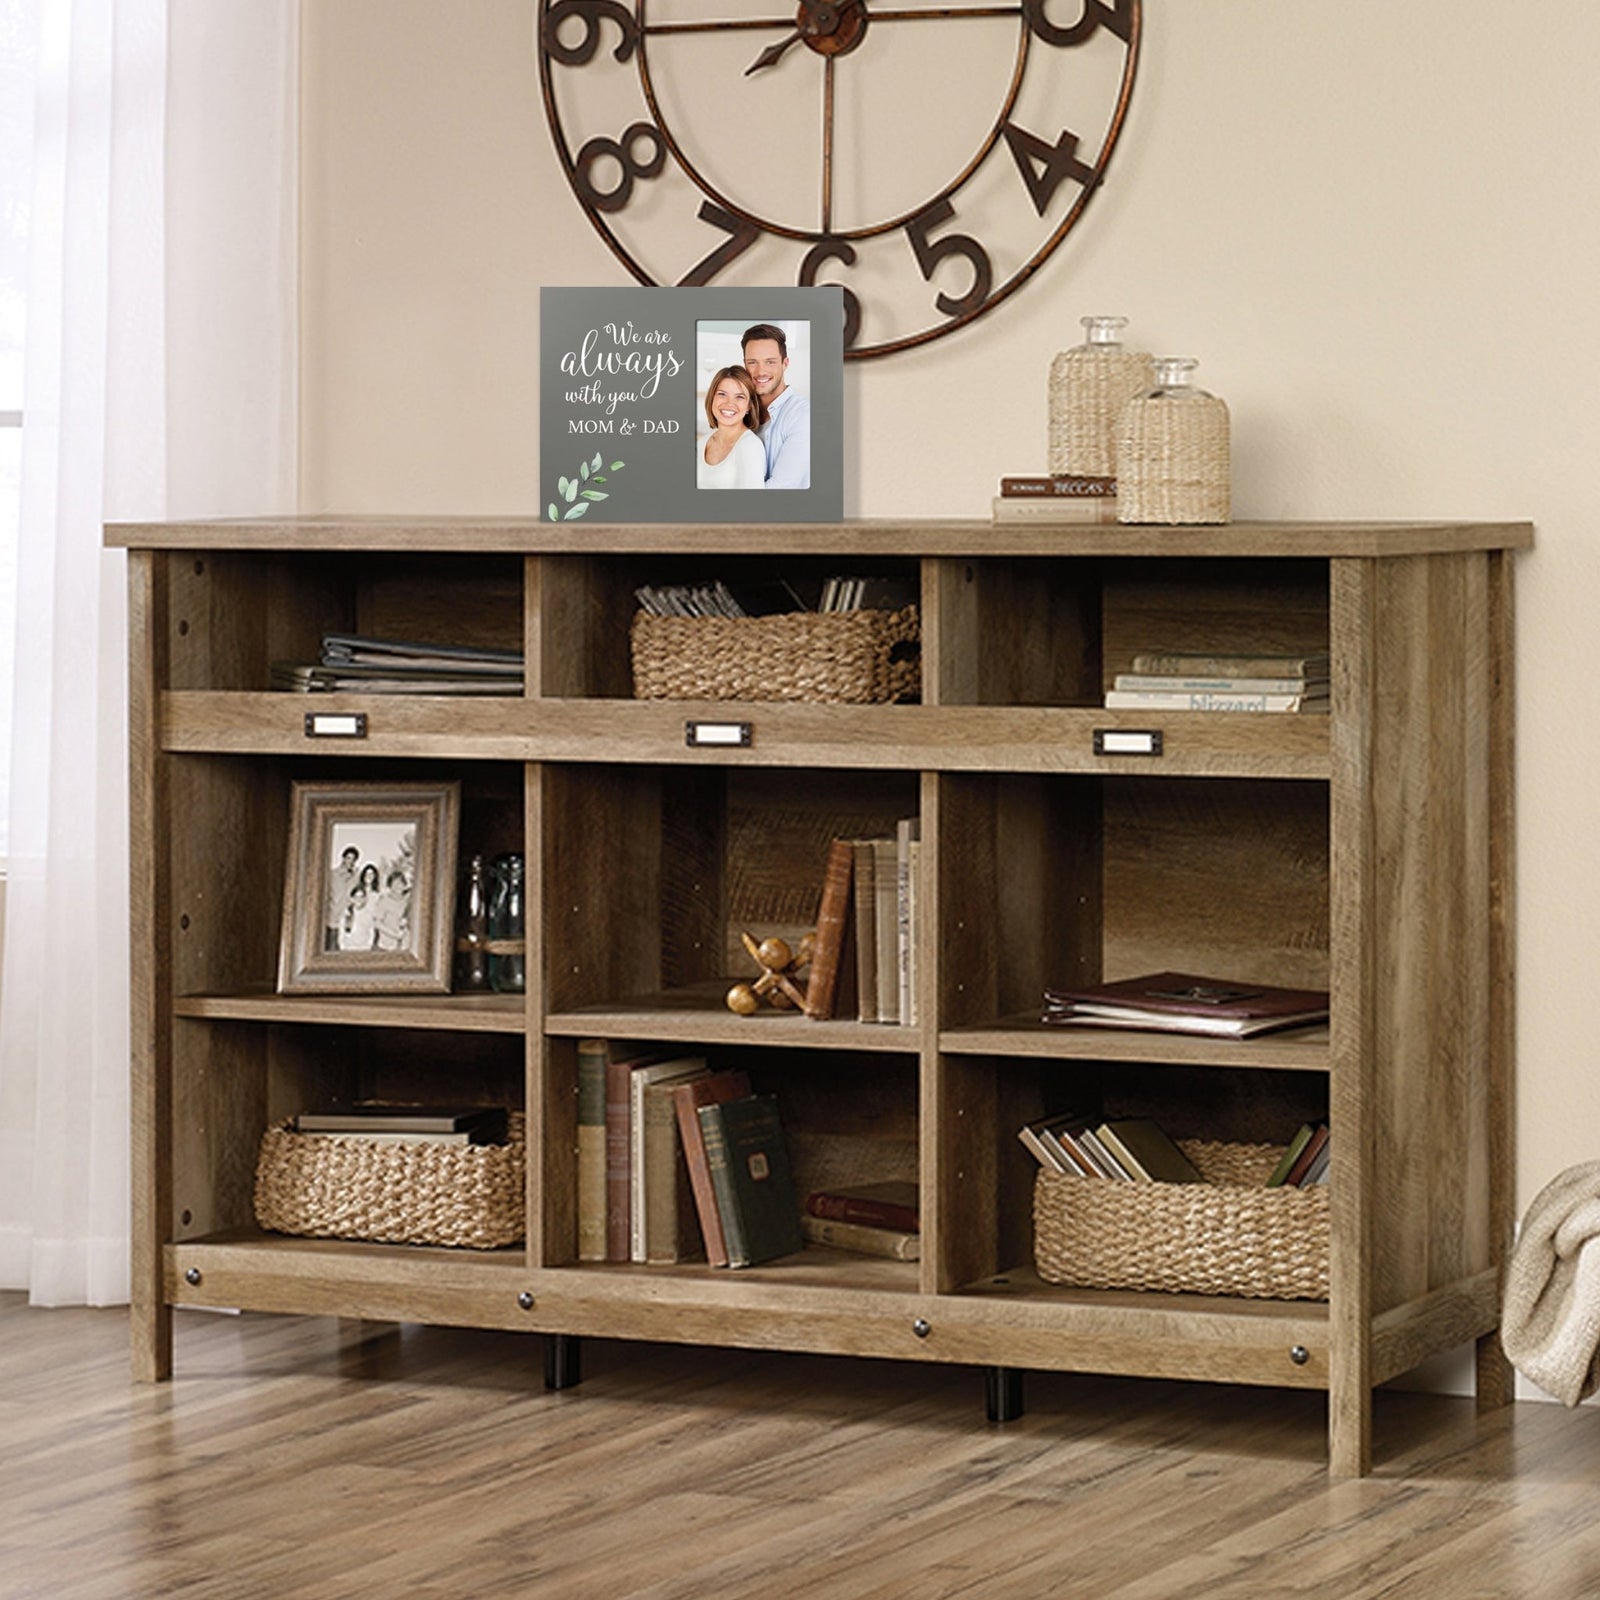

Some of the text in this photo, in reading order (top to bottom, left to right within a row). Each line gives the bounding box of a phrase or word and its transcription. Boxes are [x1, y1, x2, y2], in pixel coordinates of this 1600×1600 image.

[573, 121, 667, 213] 8
[1003, 119, 1103, 217] 4
[676, 200, 760, 287] 7
[902, 199, 993, 317] 5
[560, 329, 685, 399] always
[603, 320, 671, 346] We are
[565, 379, 639, 415] with you
[567, 418, 680, 435] MOM & DAD
